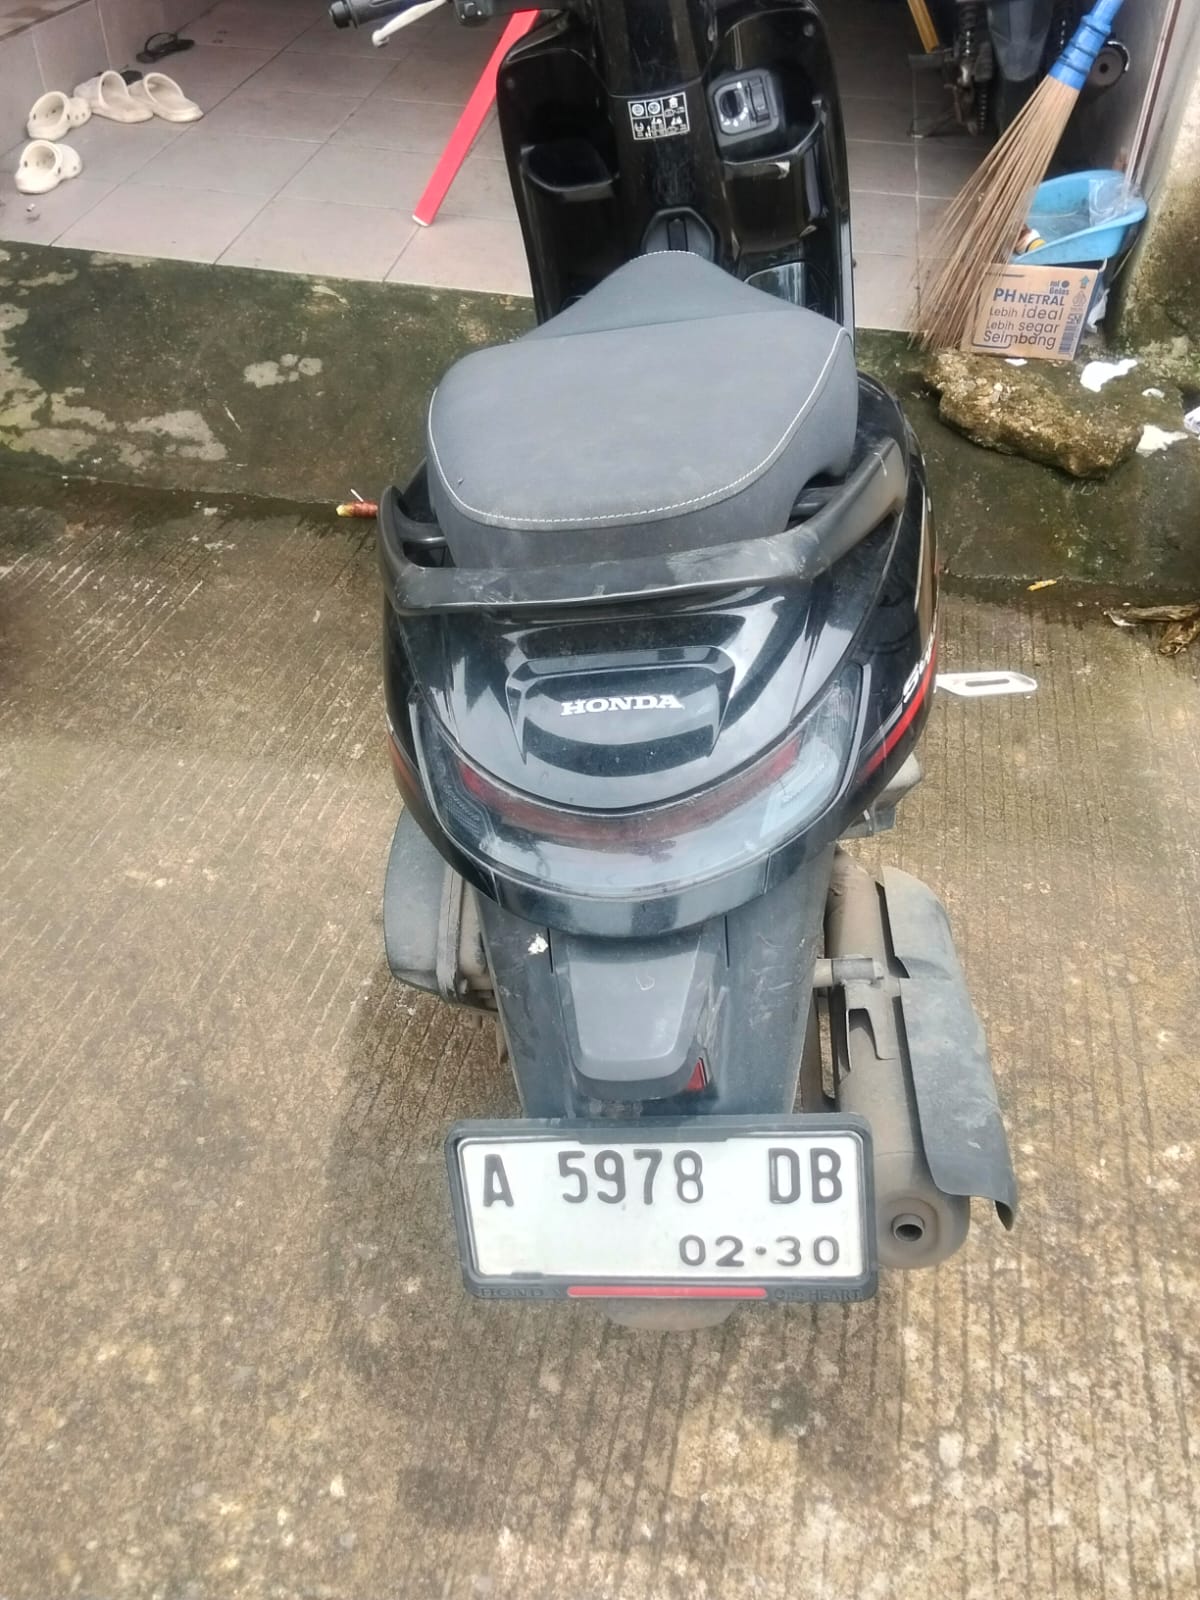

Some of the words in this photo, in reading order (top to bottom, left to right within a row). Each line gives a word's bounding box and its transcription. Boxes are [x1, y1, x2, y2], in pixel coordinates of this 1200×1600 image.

[993, 288, 1017, 303] PH
[1018, 293, 1065, 306] NETRAL
[990, 306, 1018, 318] Lebih
[1021, 304, 1064, 320] ideal
[986, 320, 1015, 331] Lebih
[1018, 321, 1060, 336] segar
[983, 331, 1057, 350] Seimbang
[560, 694, 683, 716] HONDA
[482, 1153, 515, 1208] A
[557, 1149, 704, 1205] 5978
[768, 1147, 843, 1205] DB
